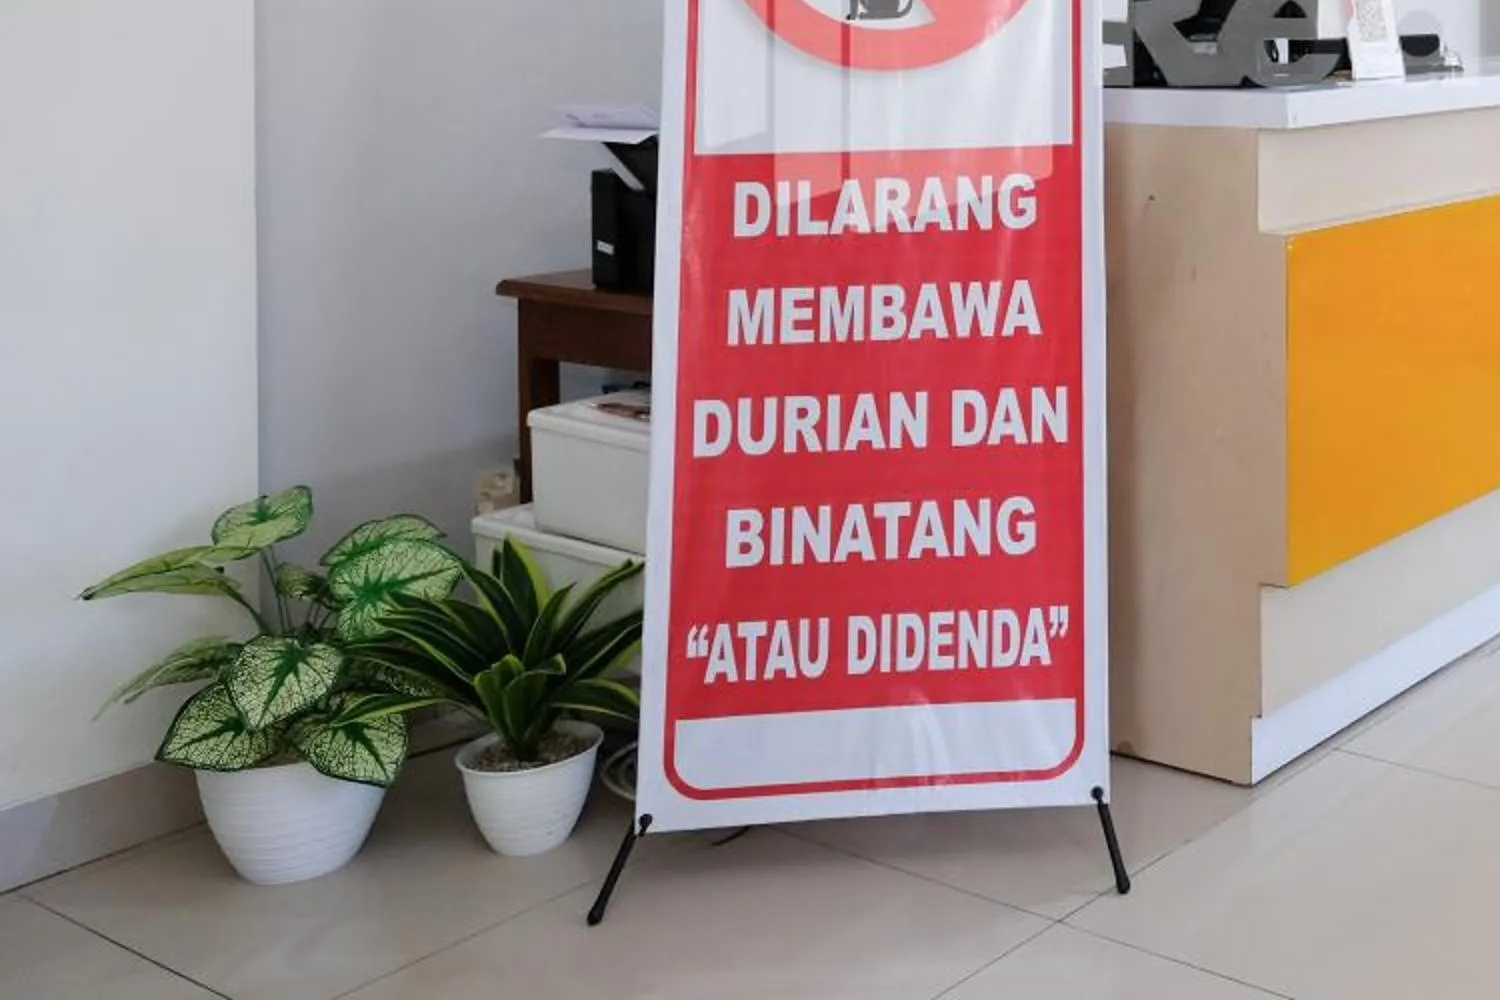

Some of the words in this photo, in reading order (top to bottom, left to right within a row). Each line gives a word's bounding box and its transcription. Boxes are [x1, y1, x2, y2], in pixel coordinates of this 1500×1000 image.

[733, 173, 1037, 238] DILARANG
[726, 279, 1042, 346] MEMBAWA
[692, 390, 929, 458] DURIAN
[950, 385, 1069, 447] DAN
[725, 496, 1037, 569] BINATANG
